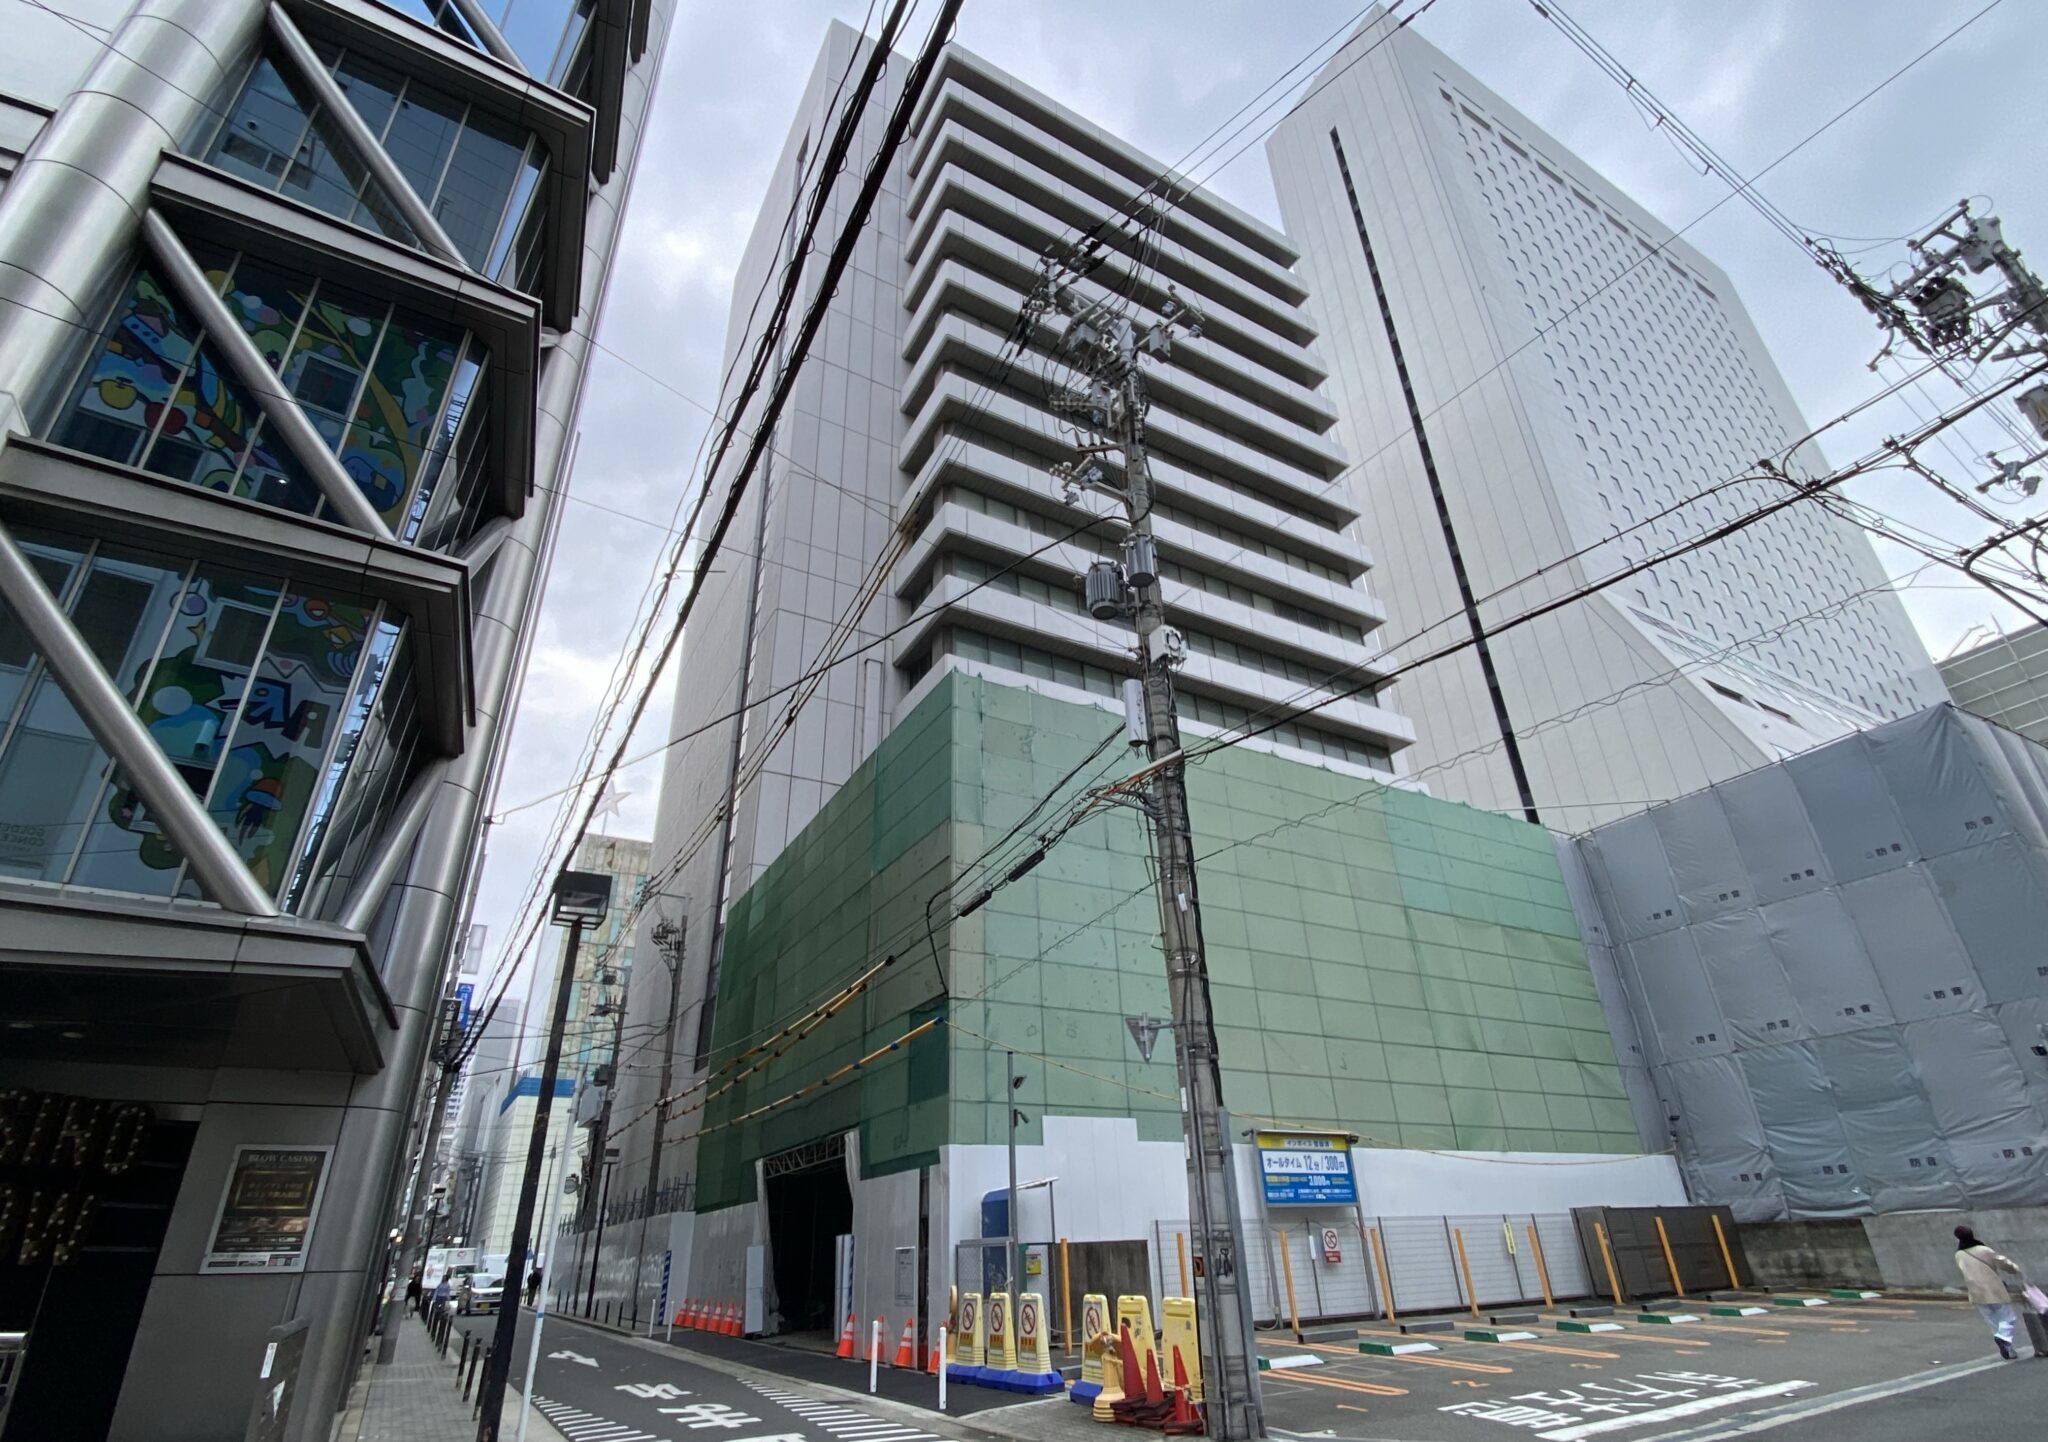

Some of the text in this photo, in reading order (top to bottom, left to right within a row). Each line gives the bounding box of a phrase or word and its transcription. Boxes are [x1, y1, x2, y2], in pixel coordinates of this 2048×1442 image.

[1266, 1156, 1302, 1169] オールタイム
